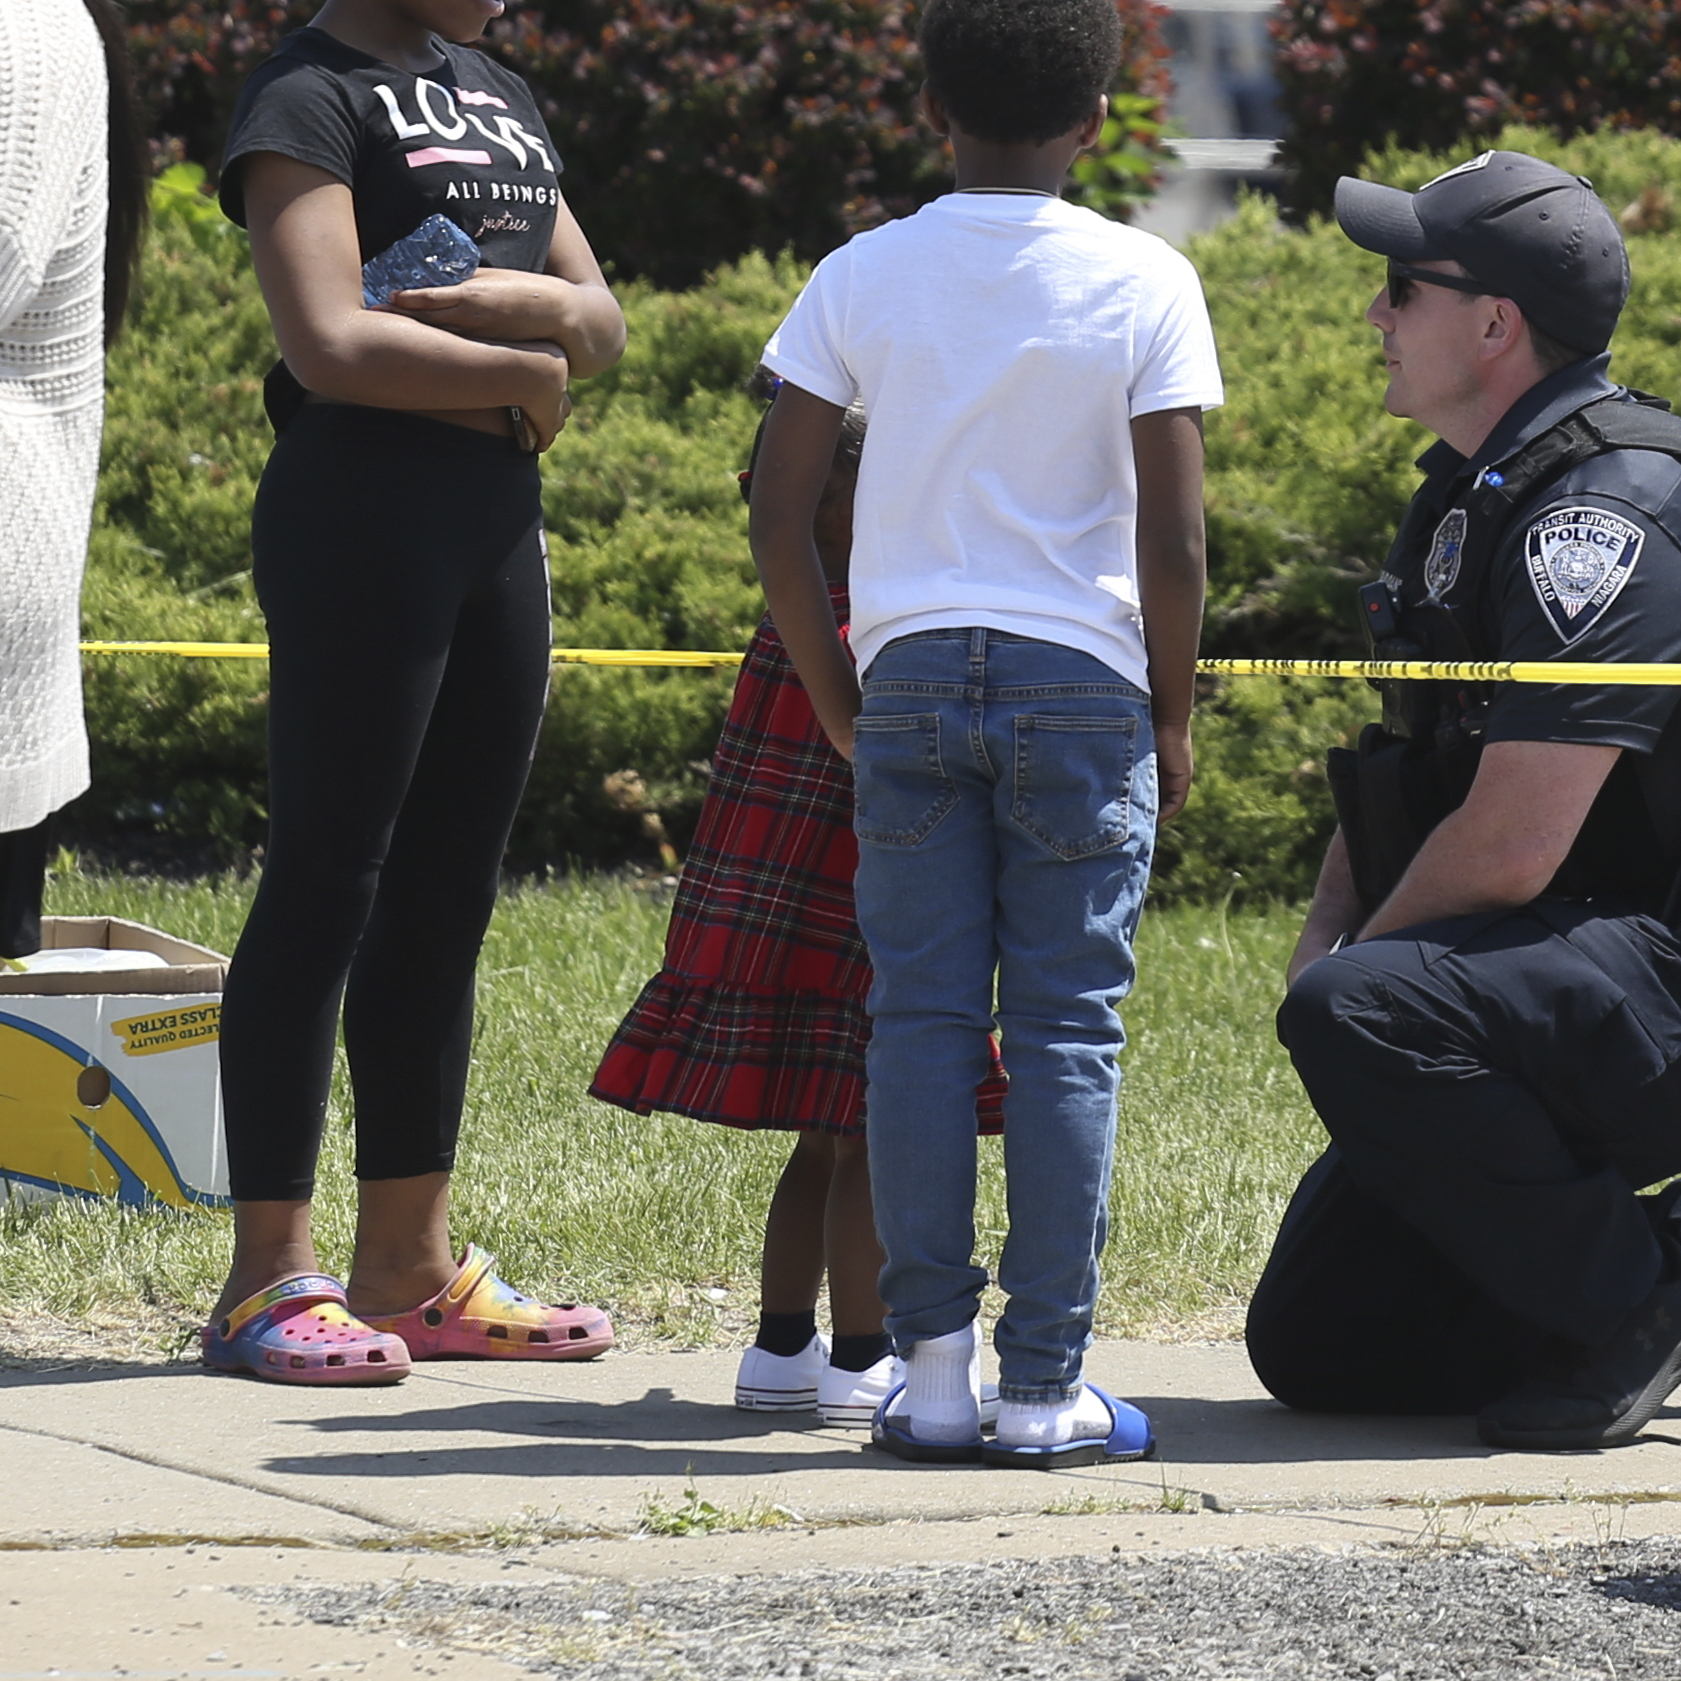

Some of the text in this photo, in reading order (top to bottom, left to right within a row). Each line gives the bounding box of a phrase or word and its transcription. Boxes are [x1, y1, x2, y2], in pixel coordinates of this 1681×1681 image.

[372, 76, 555, 173] LOVE
[445, 181, 557, 207] ALL BEINGS
[474, 210, 531, 238] justice
[1532, 512, 1639, 544] TRANSIT AUTHORITY
[1544, 527, 1621, 552] POLICE
[1531, 553, 1557, 603] BUFFALO
[1590, 564, 1628, 609] NIAGARA
[127, 1015, 178, 1036] EXTRA
[130, 1023, 220, 1050] LECTED QUALITY
